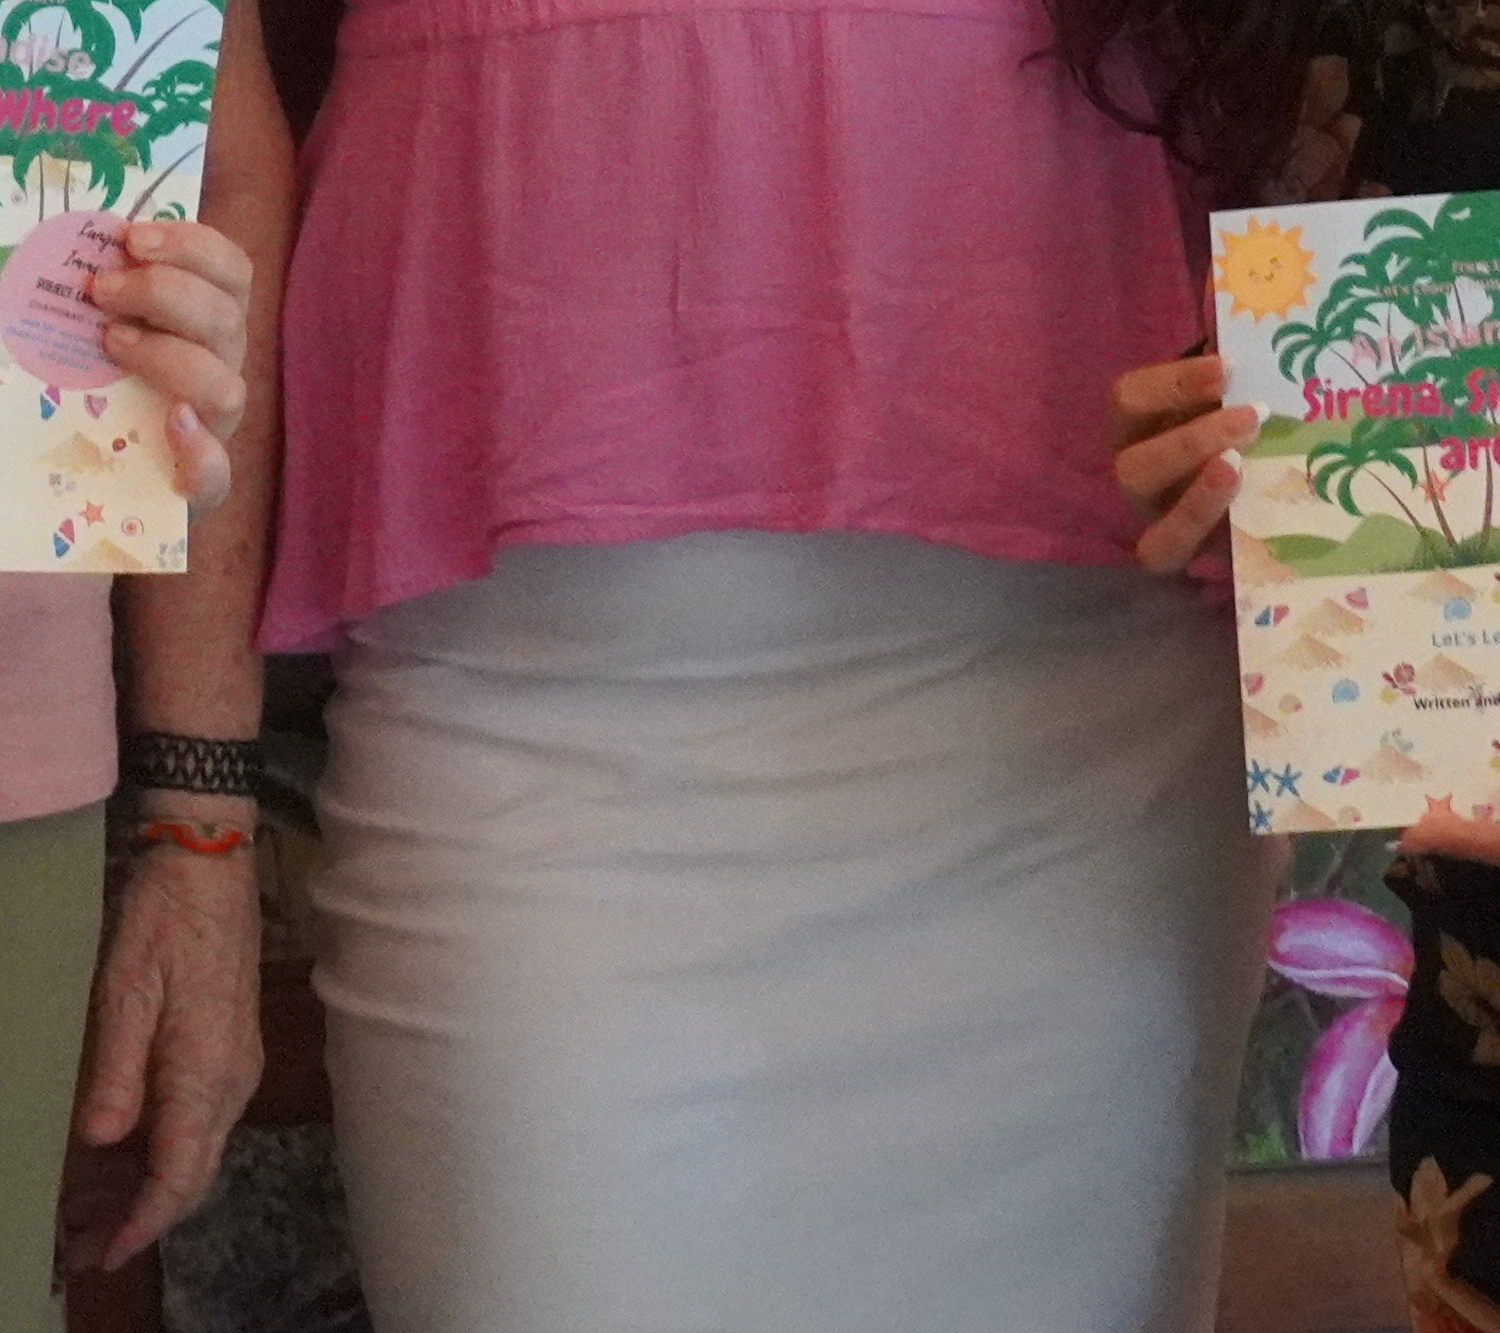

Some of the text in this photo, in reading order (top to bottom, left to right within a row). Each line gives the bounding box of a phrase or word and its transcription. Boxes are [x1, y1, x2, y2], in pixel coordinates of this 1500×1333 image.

[1302, 377, 1453, 423] Sirena,
[1431, 631, 1477, 648] Let's
[1413, 695, 1471, 711] Written
[1476, 692, 1500, 708] and
